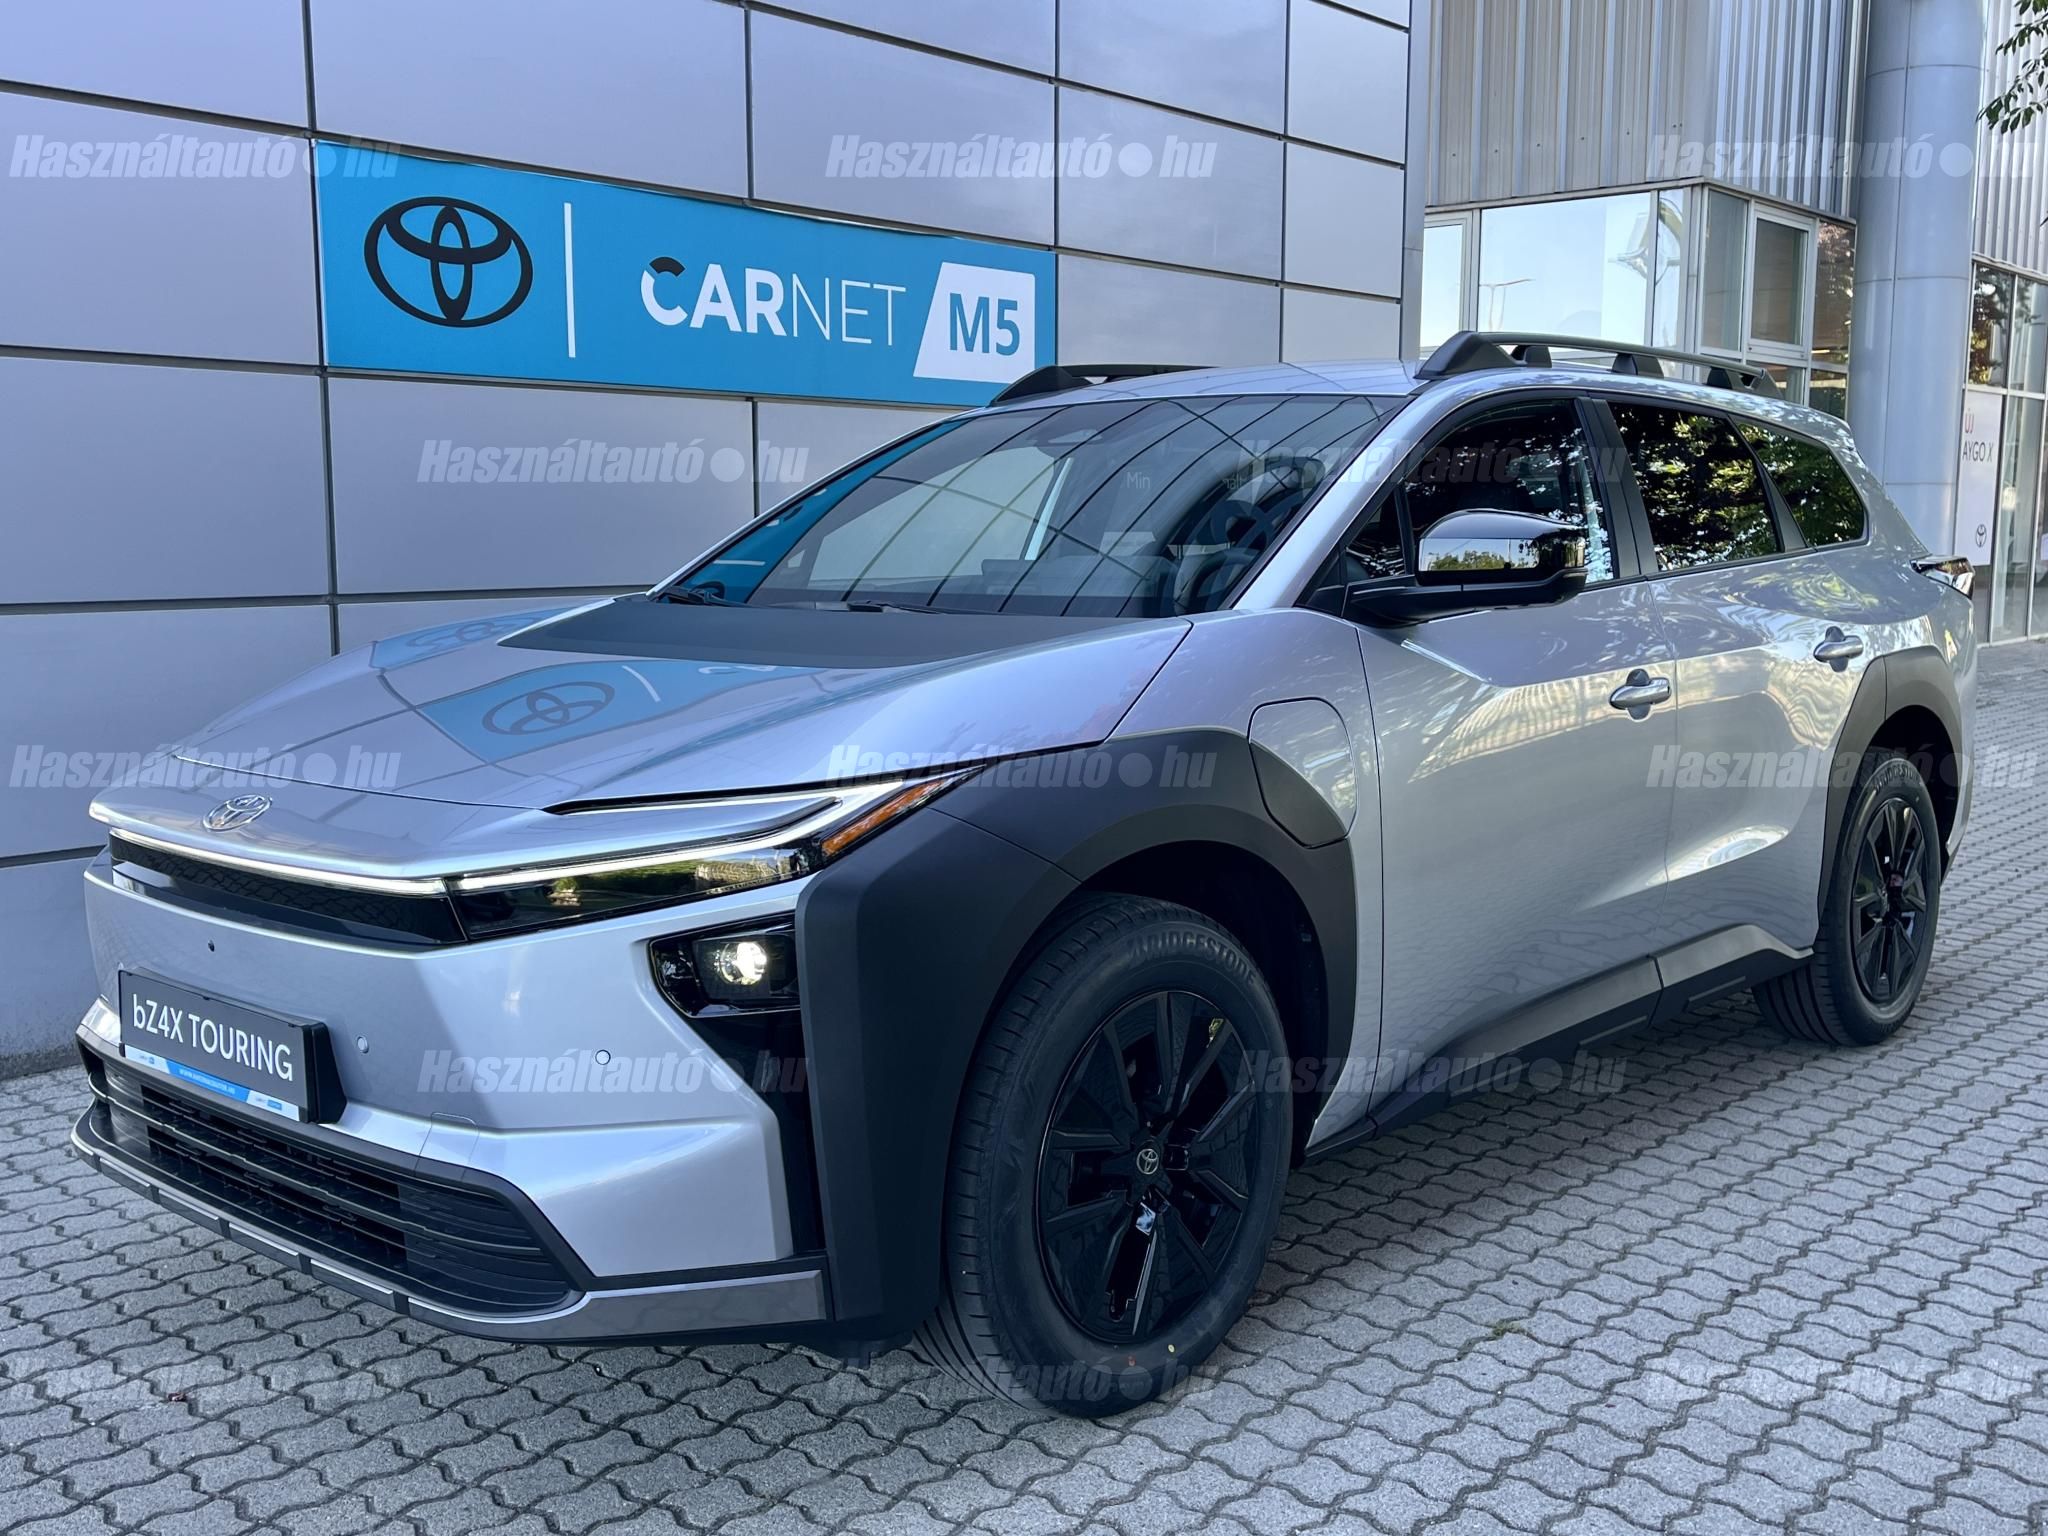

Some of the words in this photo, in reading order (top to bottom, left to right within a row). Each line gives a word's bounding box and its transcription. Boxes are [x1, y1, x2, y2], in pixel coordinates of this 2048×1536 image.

[641, 256, 906, 346] CARNET
[948, 292, 1020, 356] M5
[1962, 440, 1986, 462] AYGO
[1987, 441, 1994, 462] X
[1126, 471, 1151, 489] Min
[132, 994, 184, 1043] bZ4X
[188, 1013, 293, 1082] TOURING
